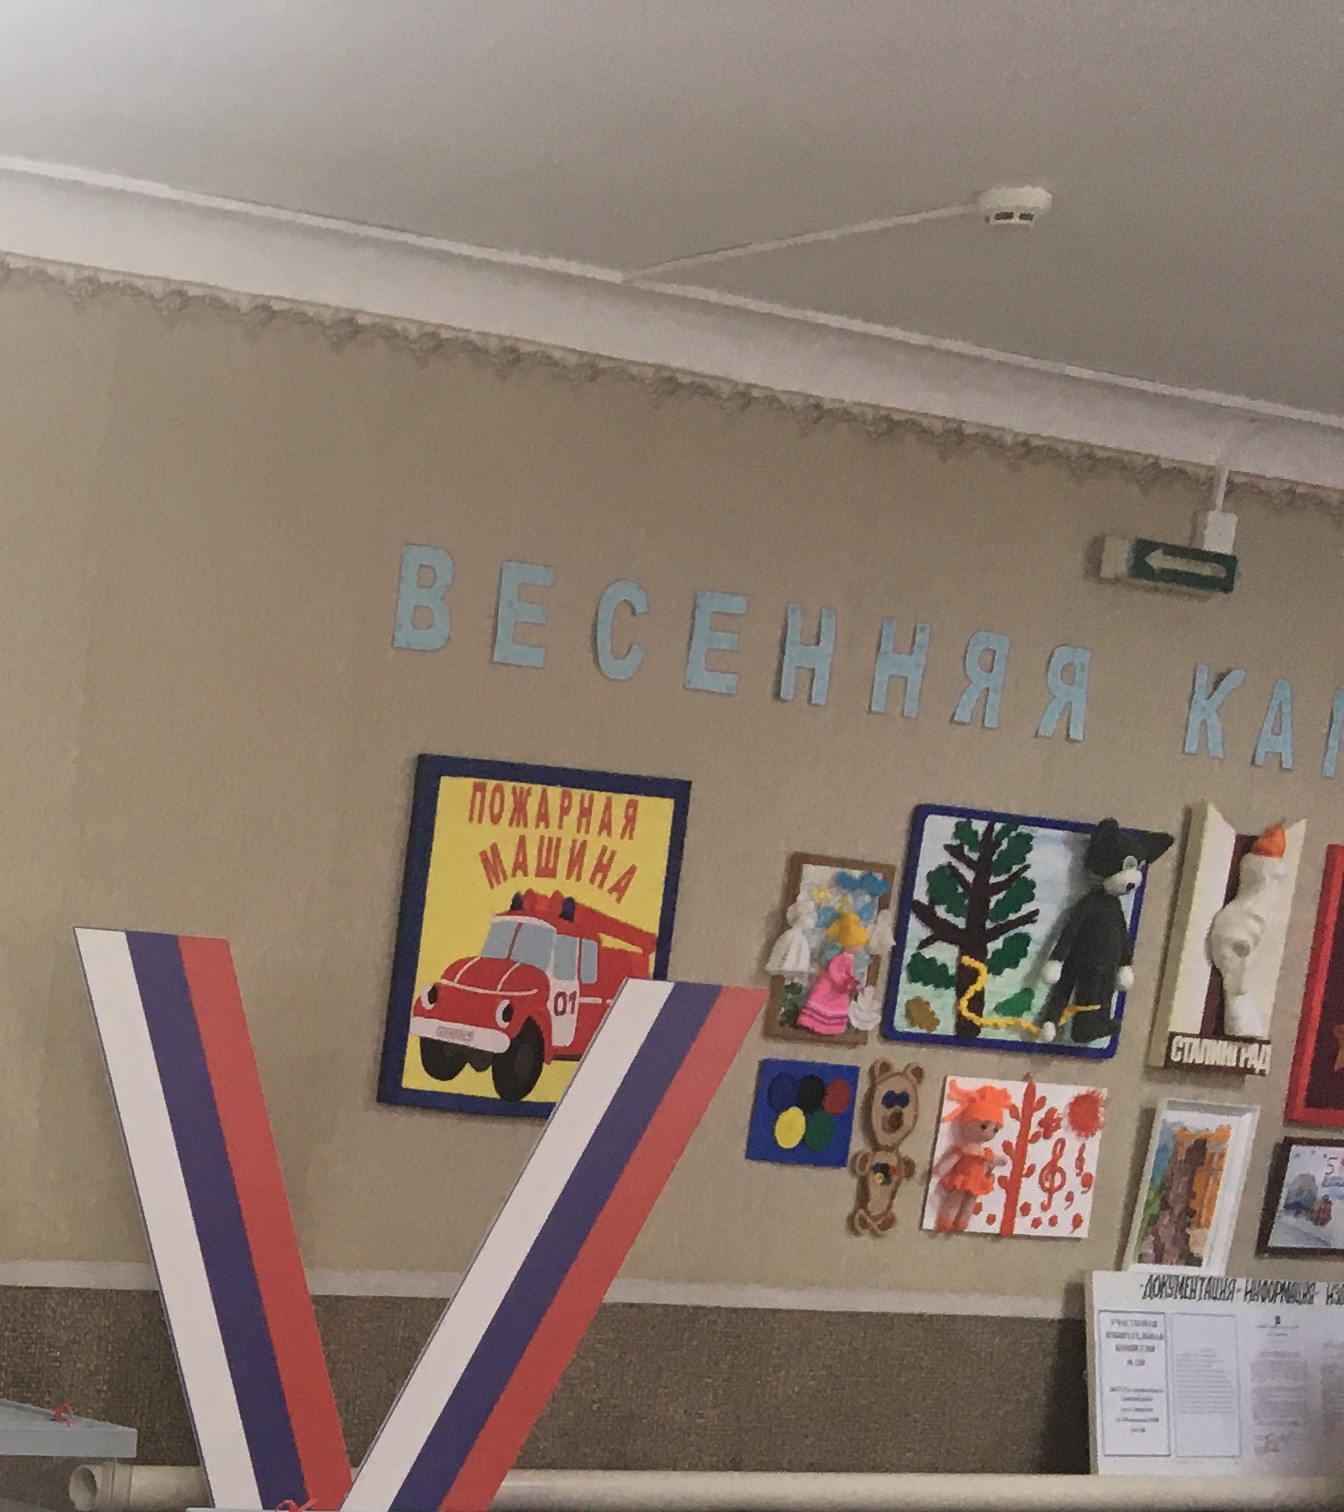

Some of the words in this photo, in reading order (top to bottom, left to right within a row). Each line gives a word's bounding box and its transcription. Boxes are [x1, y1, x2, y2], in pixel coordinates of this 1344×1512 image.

[393, 543, 1092, 742] ВЕСЕННЯЯ
[468, 780, 640, 841] ПОЖАРНАЯ
[478, 834, 639, 905] МАШИНА
[553, 991, 577, 1017] 01
[1170, 1035, 1272, 1075] СТАЛИНГРАД
[1142, 1274, 1237, 1302] ДОКУМЕНТАЦИЯ
